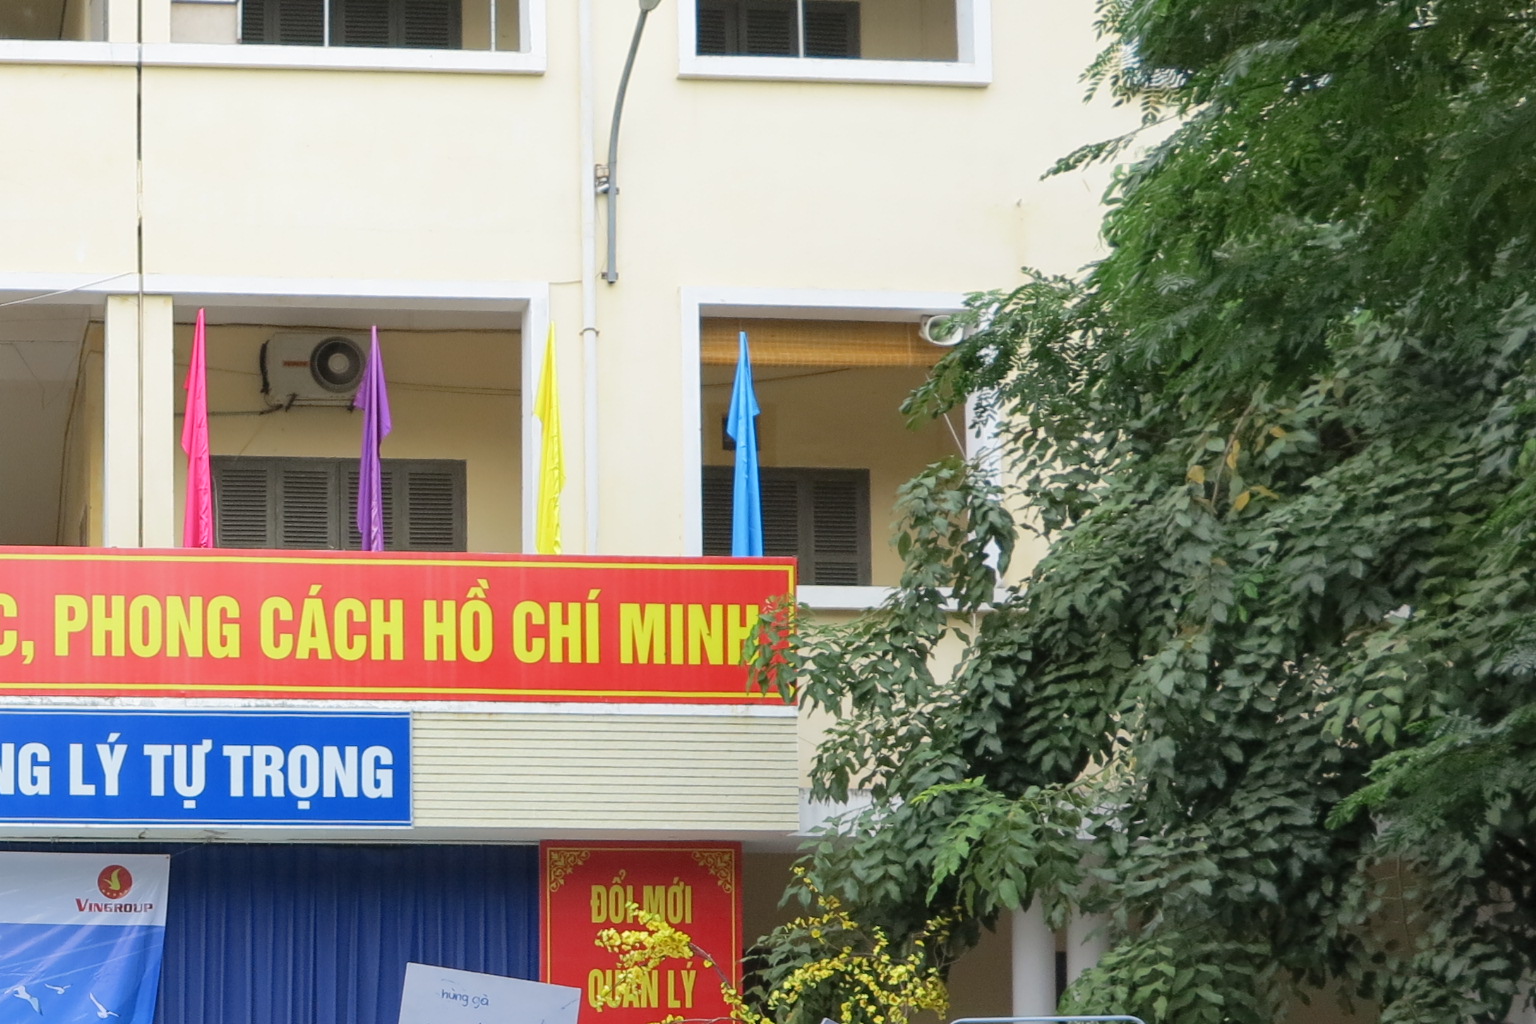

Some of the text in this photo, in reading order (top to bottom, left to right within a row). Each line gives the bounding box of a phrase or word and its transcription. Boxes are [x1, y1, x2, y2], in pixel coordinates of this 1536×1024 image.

[54, 594, 241, 659] PHONG
[260, 584, 404, 662] CÁCH
[423, 578, 493, 664] HỒ
[512, 589, 600, 665] CHÍ
[619, 603, 759, 666] MINH
[69, 732, 128, 797] LÝ
[144, 739, 212, 810] TỰ
[222, 744, 394, 810] TRỌNG
[590, 869, 692, 924] ĐỔI MỚI
[667, 961, 697, 1009] LÝ
